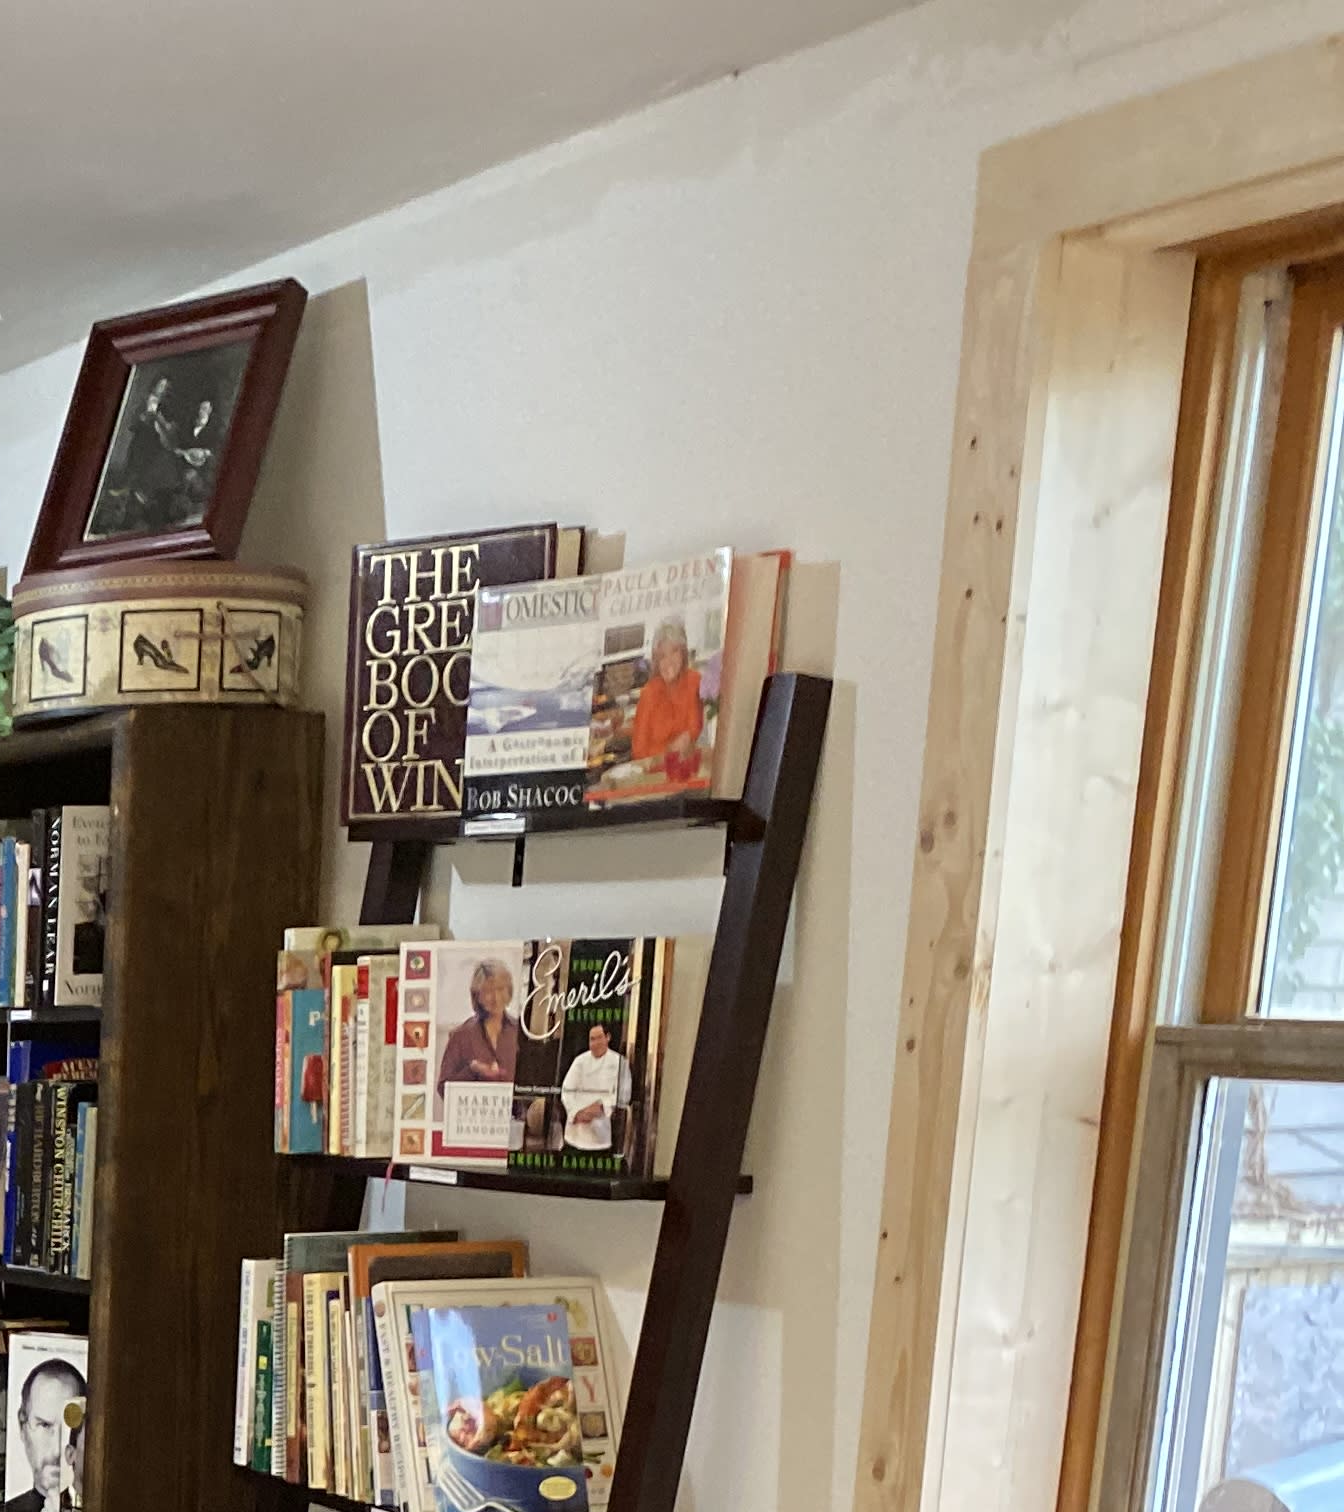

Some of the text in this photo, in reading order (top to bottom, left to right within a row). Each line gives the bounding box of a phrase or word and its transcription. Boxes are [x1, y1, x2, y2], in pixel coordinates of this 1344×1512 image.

[369, 544, 480, 607] THE
[603, 553, 718, 598] PAULA DEEN
[365, 598, 472, 659] GRE
[363, 652, 472, 711] BOO
[361, 708, 437, 763] OF
[468, 753, 558, 770] Interpretation
[361, 759, 464, 814] WIN
[467, 779, 583, 812] BOB SHACOC
[43, 814, 63, 976] NORMAN LEAR
[520, 945, 642, 1041] Emeril's
[572, 959, 604, 972] FROM
[456, 1109, 510, 1119] STEWAR
[457, 1095, 512, 1107] MARTH
[455, 1124, 508, 1136] HANDBOO
[50, 1086, 67, 1257] WINSTON CHURCHILL
[508, 1153, 556, 1168] EMERIL
[383, 1370, 399, 1432] HEALTHY
[391, 1433, 407, 1489] RECIPES
